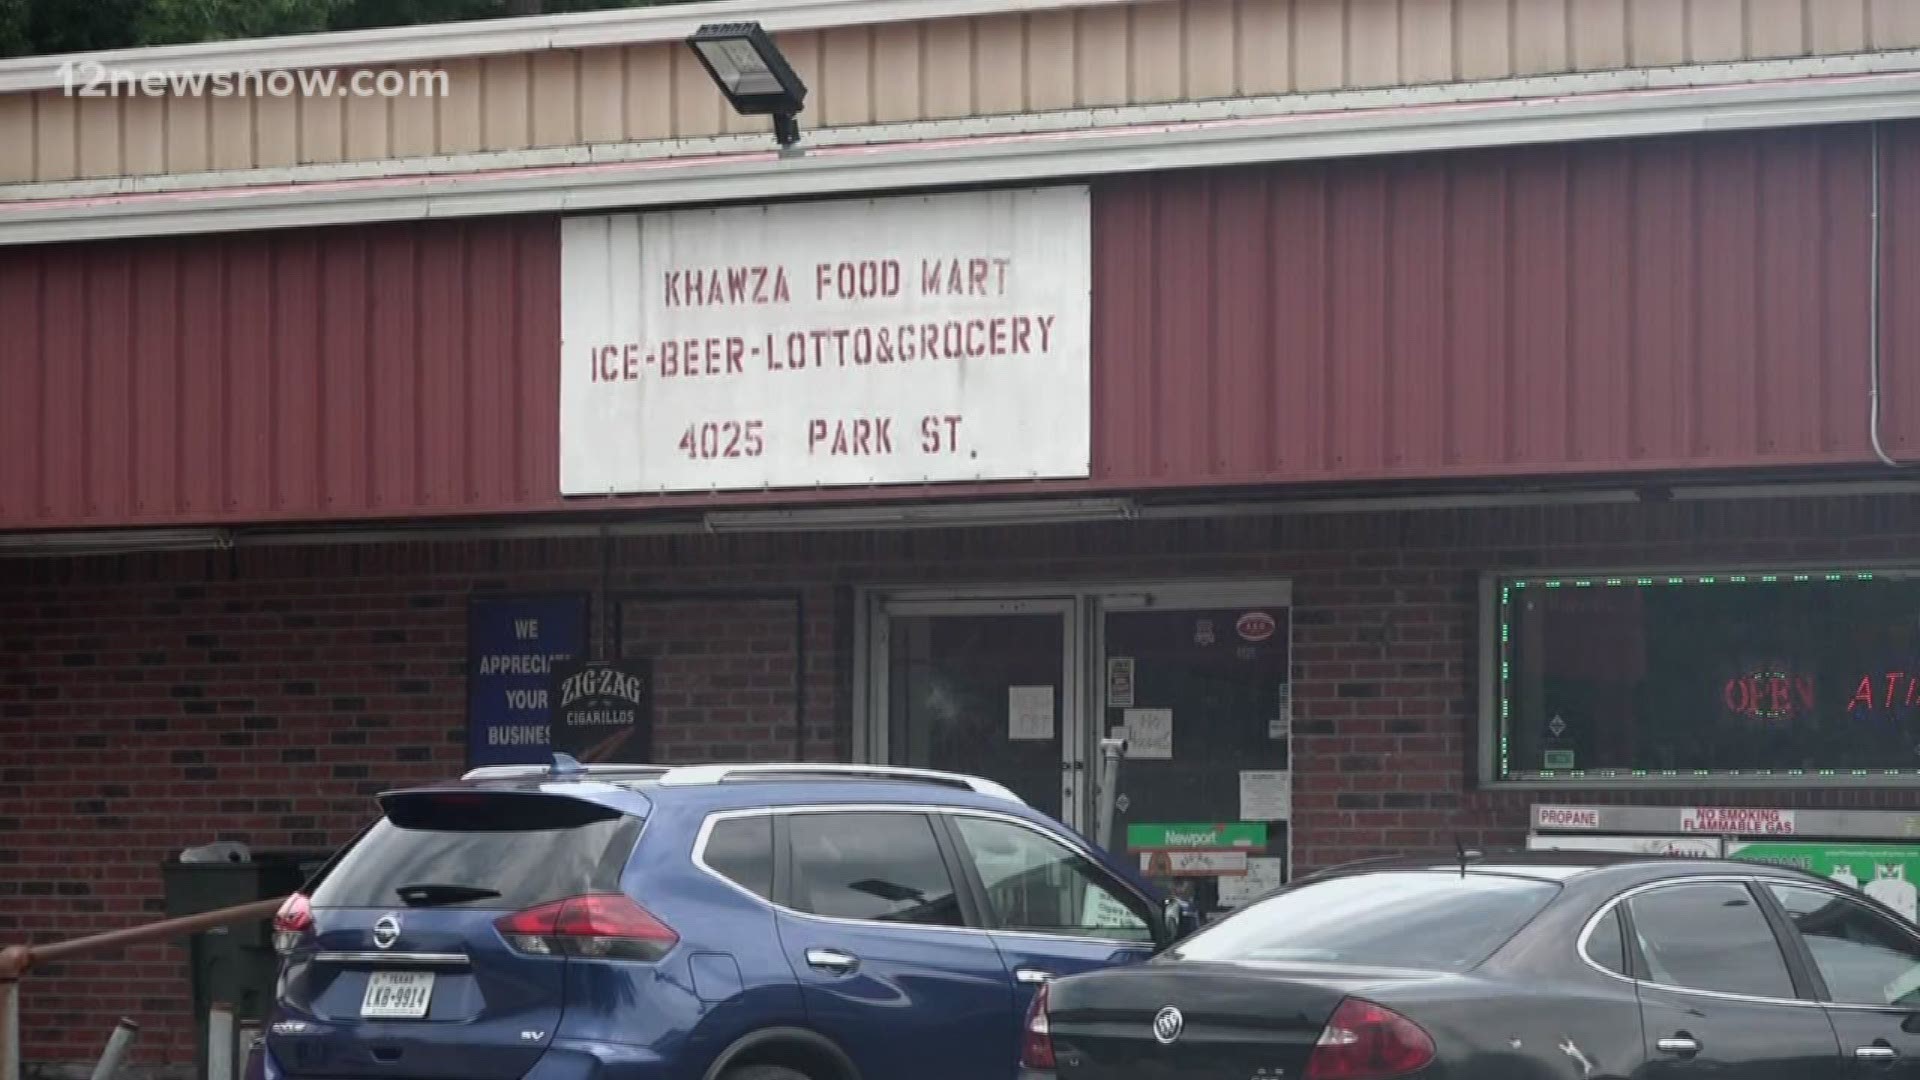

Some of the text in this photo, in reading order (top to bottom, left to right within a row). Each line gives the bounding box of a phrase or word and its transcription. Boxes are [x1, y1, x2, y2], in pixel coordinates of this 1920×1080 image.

[664, 257, 1012, 306] KHAWZA FOOD MART
[678, 414, 979, 460] 4025 PARK ST.
[515, 619, 539, 640] WE
[506, 690, 549, 709] YOUR
[566, 711, 635, 725] CIGARILLOS
[1541, 810, 1596, 825] PROPANE
[1696, 808, 1779, 820] NO SMOKING
[1683, 819, 1792, 834] FLAMMABLE GAS
[1165, 831, 1216, 846] Newport
